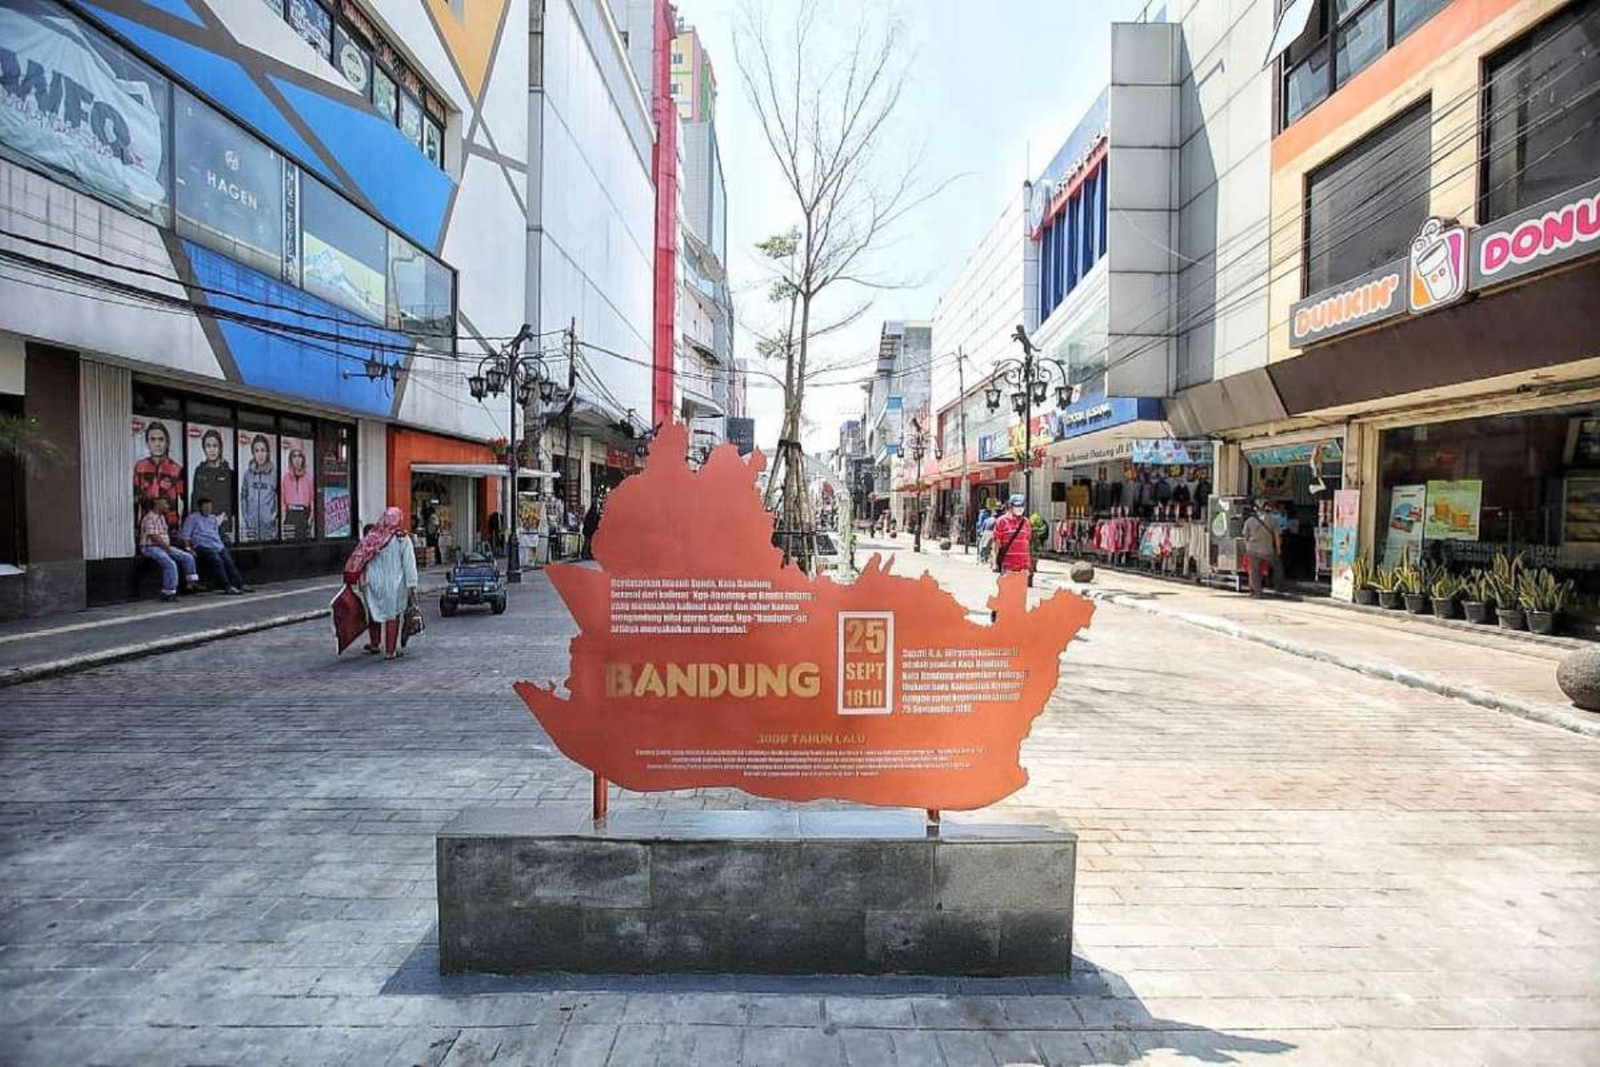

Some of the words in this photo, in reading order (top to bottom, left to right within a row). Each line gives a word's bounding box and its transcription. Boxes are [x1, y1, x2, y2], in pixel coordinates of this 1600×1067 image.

[207, 170, 257, 210] HAGEN
[1294, 274, 1400, 337] DUNKIN'
[845, 619, 885, 653] 25
[605, 661, 821, 698] BANDUNG
[845, 662, 885, 681] SEPT
[845, 689, 883, 706] 1810
